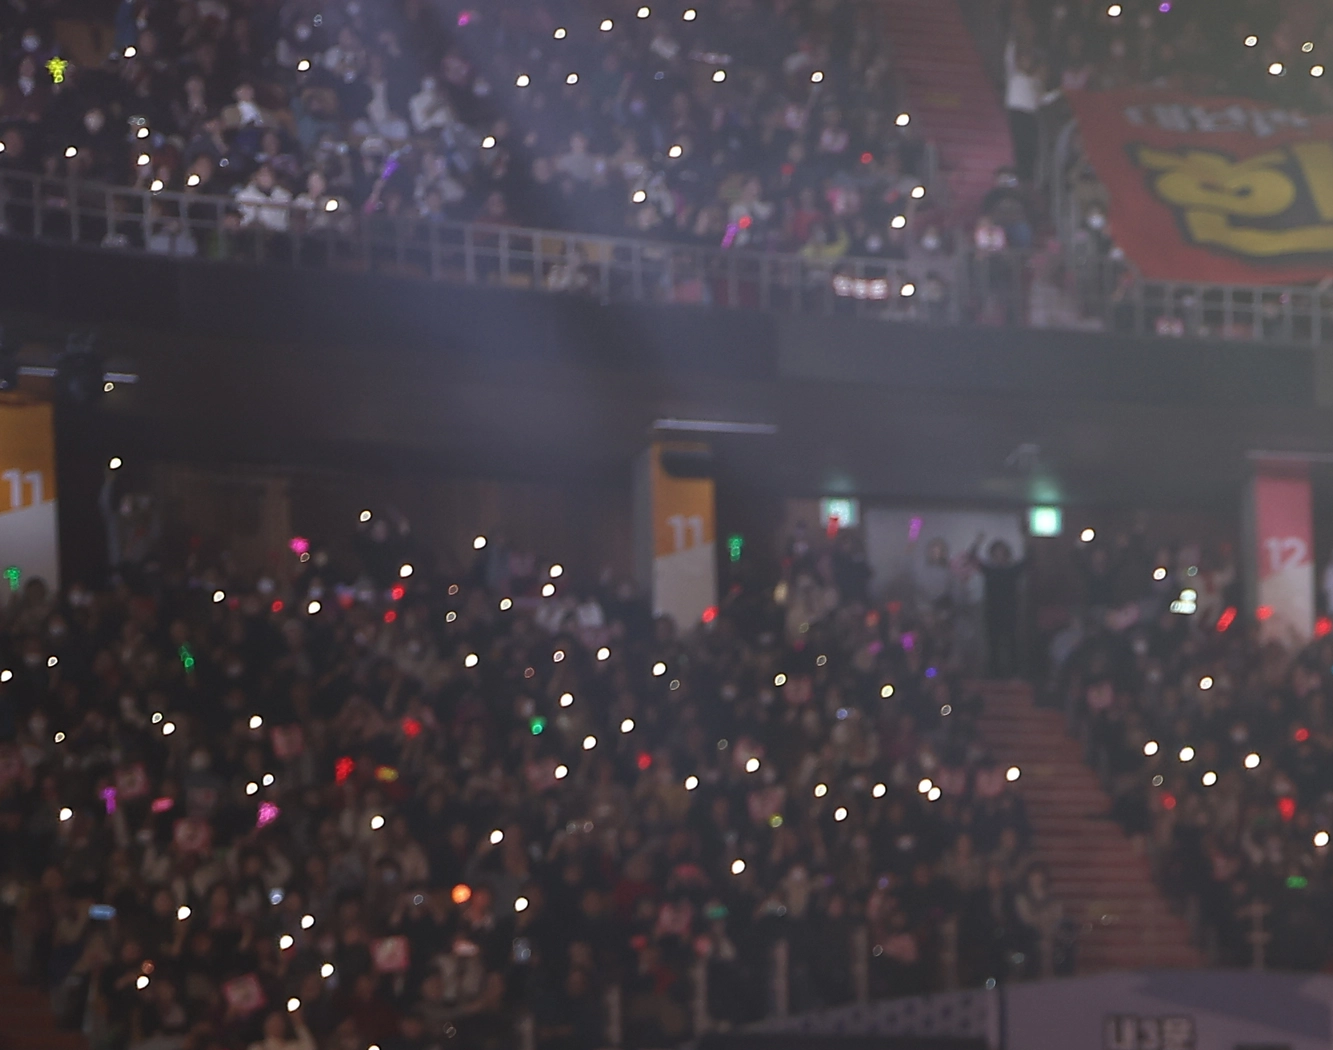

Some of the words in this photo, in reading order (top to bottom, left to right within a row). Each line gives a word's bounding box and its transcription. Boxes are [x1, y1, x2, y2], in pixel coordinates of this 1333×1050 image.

[2, 468, 43, 508] 11
[665, 515, 704, 551] 11
[1263, 537, 1307, 573] 12
